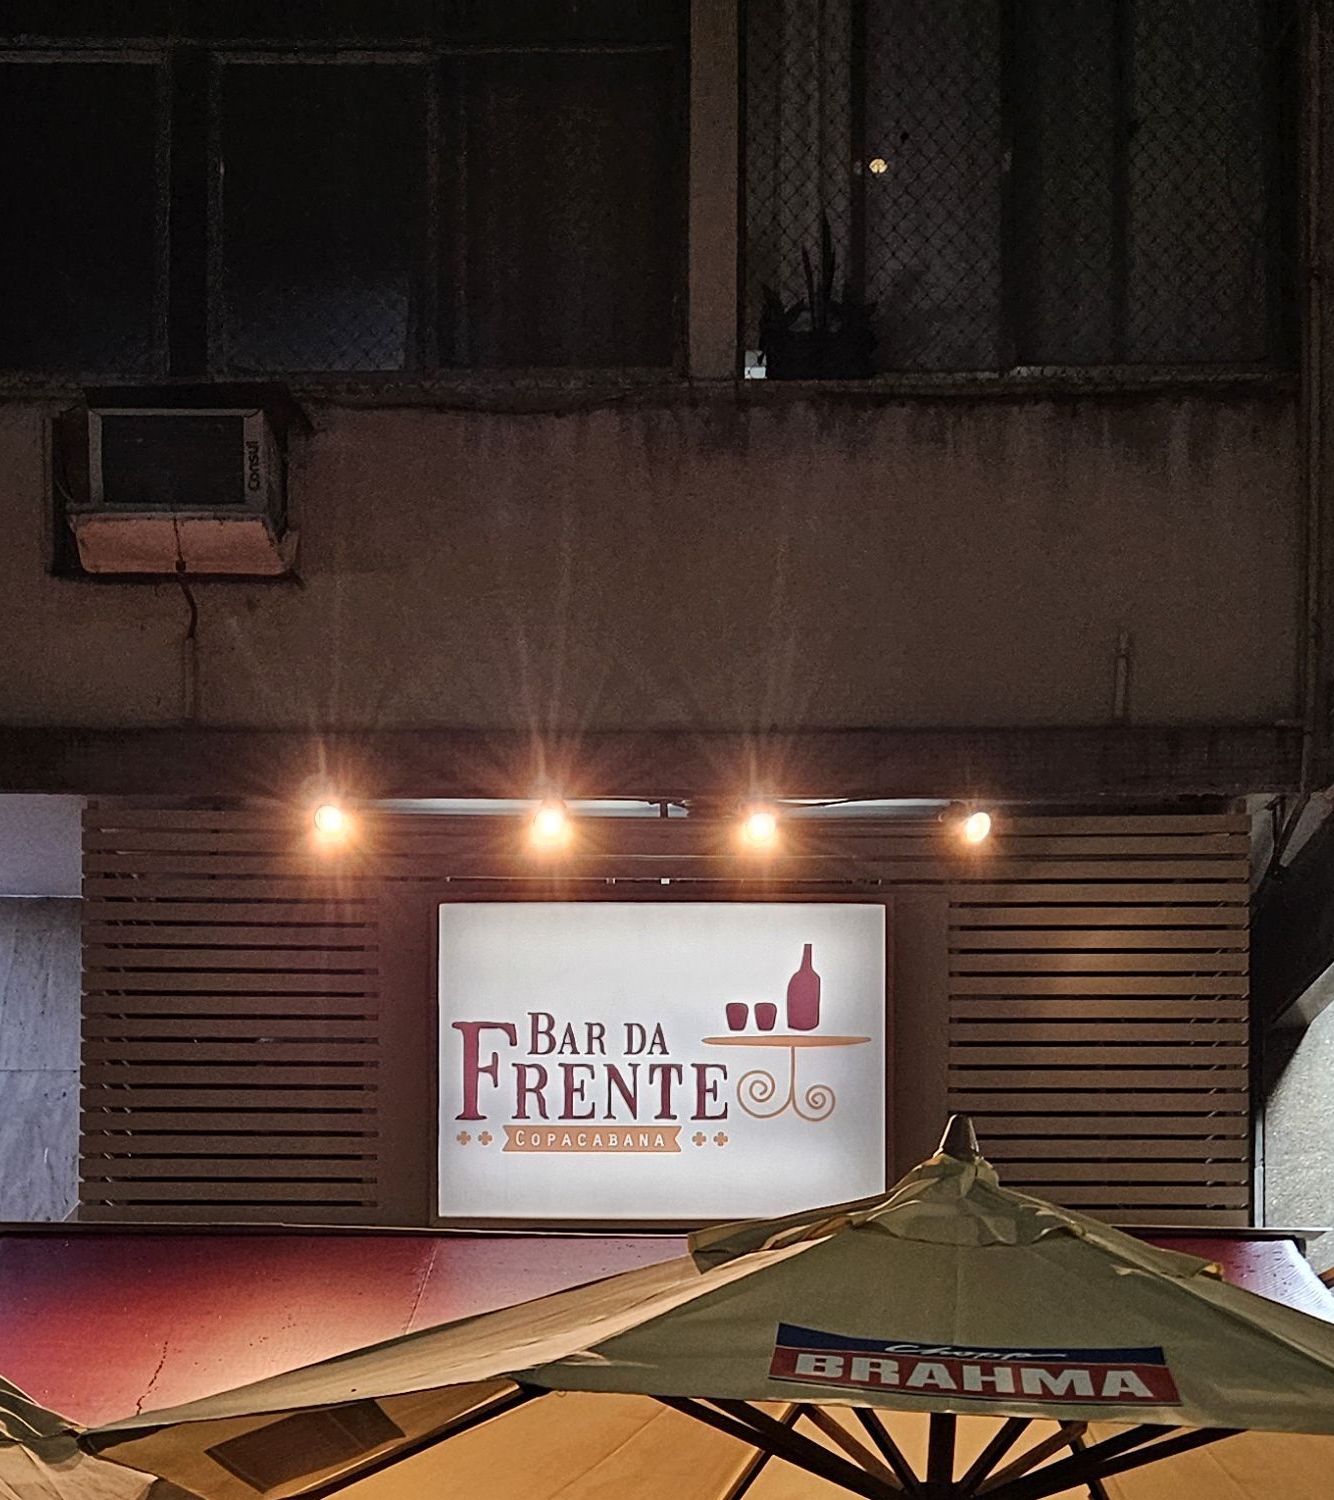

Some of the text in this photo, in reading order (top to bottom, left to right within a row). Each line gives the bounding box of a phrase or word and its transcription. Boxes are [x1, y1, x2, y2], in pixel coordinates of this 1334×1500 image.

[527, 1011, 670, 1056] BAR DA
[452, 1021, 729, 1121] FRENTE
[516, 1130, 665, 1147] COPACABANA
[794, 1352, 1156, 1398] BRAHMA
